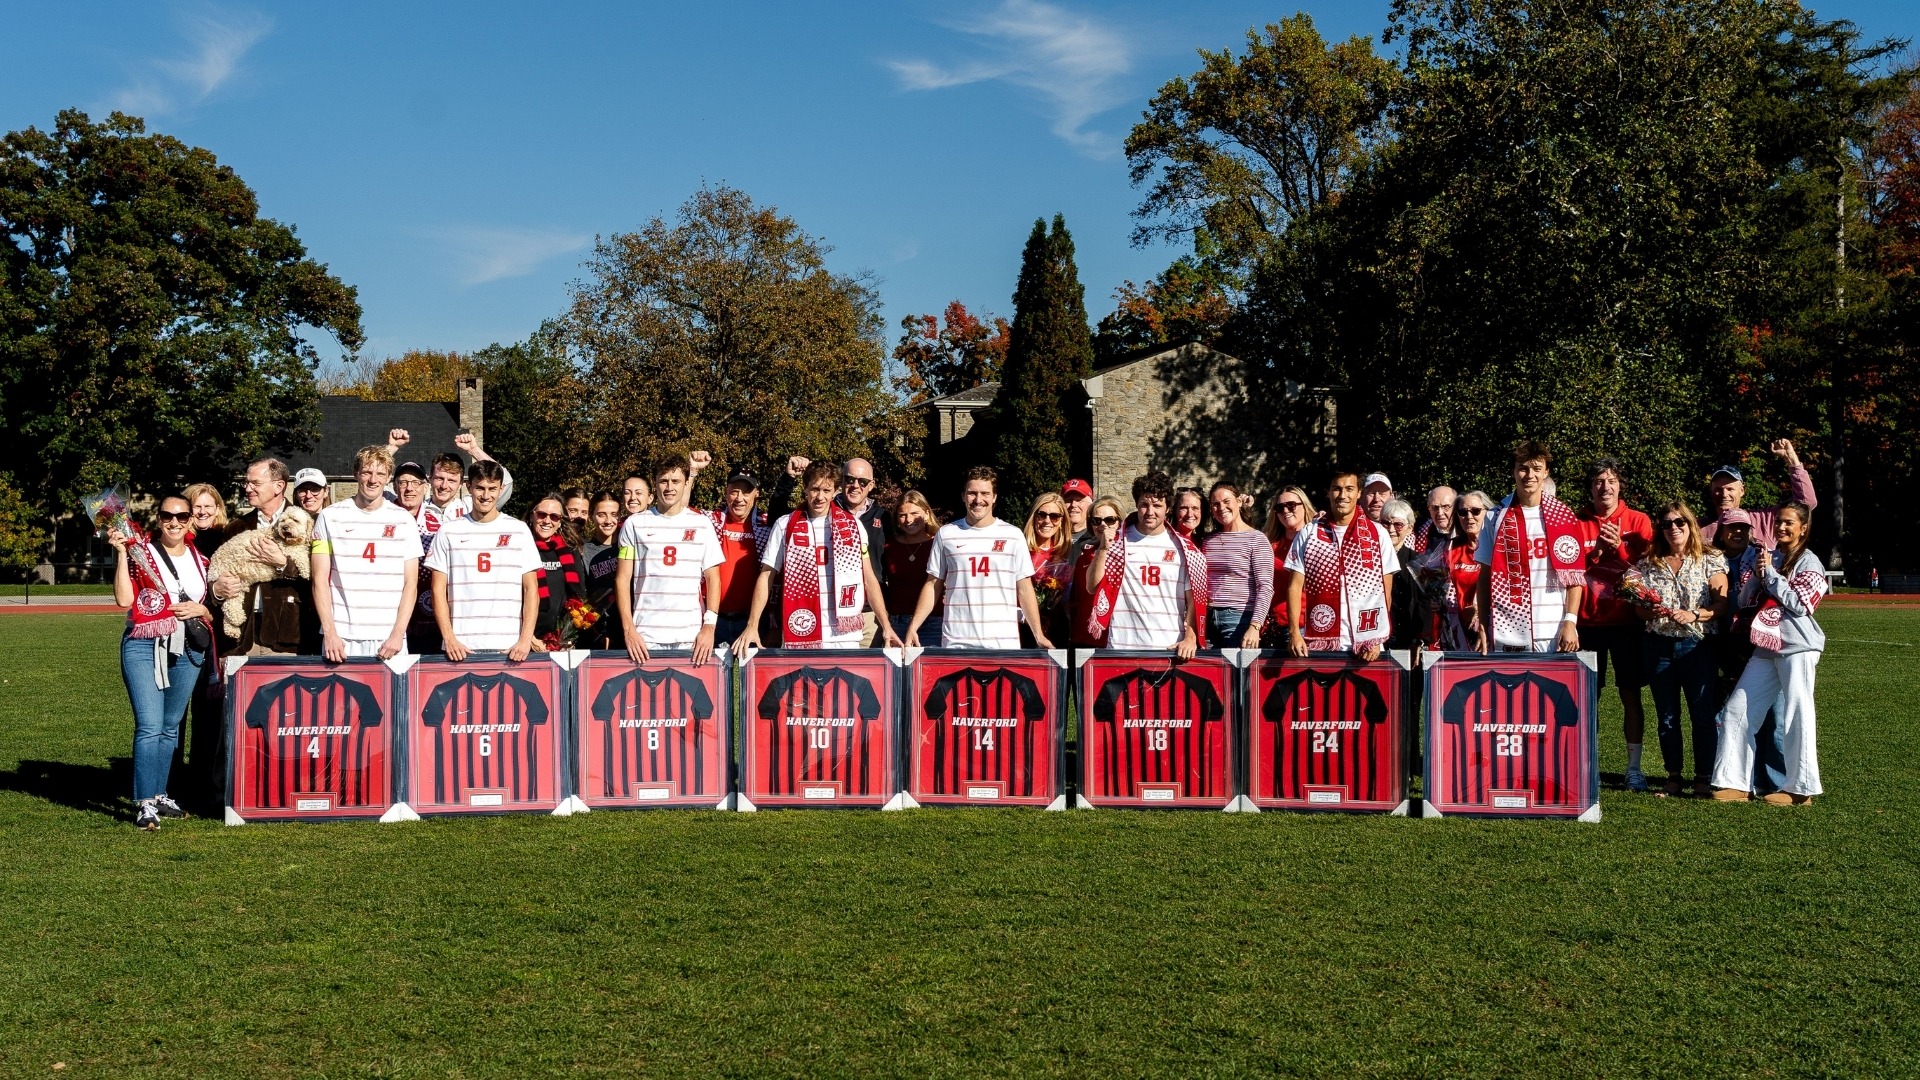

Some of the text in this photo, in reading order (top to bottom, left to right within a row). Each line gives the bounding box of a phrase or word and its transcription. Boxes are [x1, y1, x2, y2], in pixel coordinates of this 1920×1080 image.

[382, 525, 396, 538] H
[496, 534, 512, 547] H
[682, 529, 697, 542] H
[363, 543, 376, 563] 4
[663, 545, 677, 567] 8
[992, 540, 1007, 552] H
[1162, 549, 1177, 562] H
[477, 552, 491, 573] 6
[969, 556, 991, 577] 14
[1140, 565, 1161, 586] 18
[838, 583, 858, 608] H
[1356, 607, 1381, 633] H
[277, 725, 352, 737] HAVERFORD
[450, 723, 521, 734] HAVERFORD
[619, 718, 688, 729] HAVERFORD
[786, 717, 855, 727] HAVERFORD
[952, 717, 1018, 728] HAVERFORD
[1123, 719, 1193, 729] HAVERFORD
[1290, 720, 1362, 730] HAVERFORD
[1472, 723, 1547, 734] HAVERFORD
[307, 737, 321, 759] 4
[479, 735, 492, 757] 6
[647, 729, 660, 751] 8
[810, 728, 830, 749] 10
[974, 729, 994, 751] 14
[1148, 729, 1168, 751] 18
[1312, 731, 1339, 753] 24
[1496, 735, 1523, 757] 28
